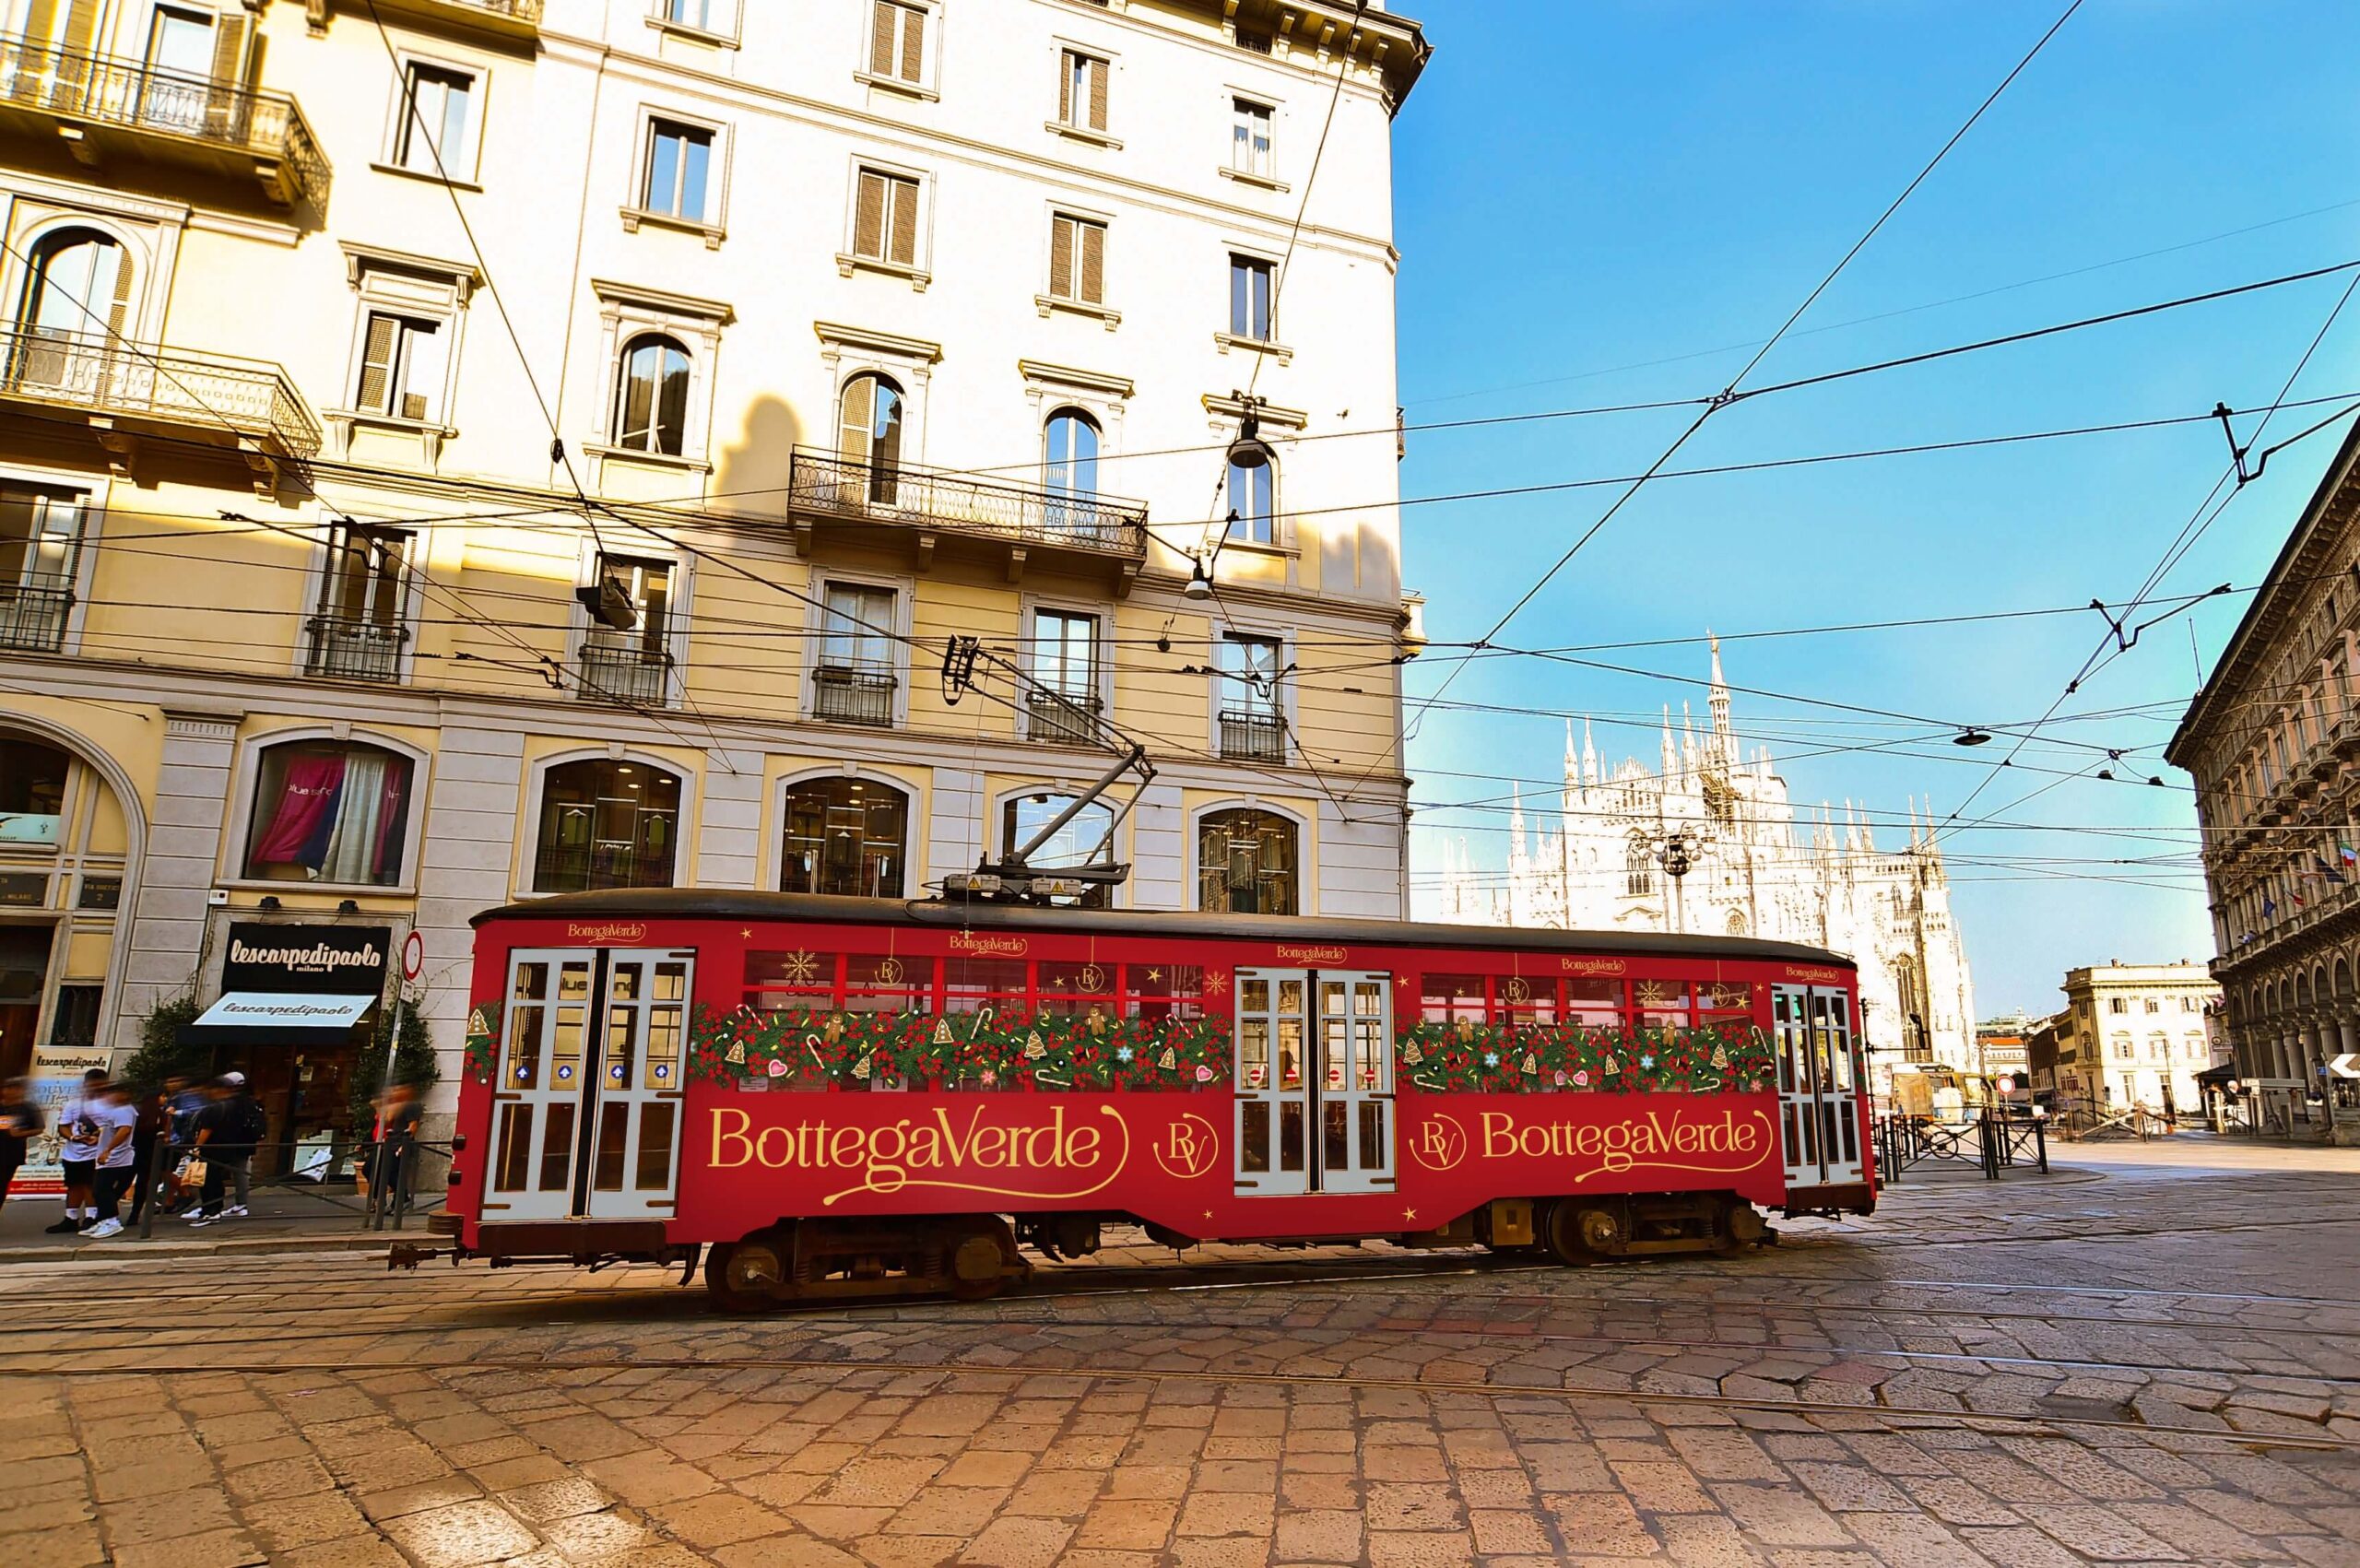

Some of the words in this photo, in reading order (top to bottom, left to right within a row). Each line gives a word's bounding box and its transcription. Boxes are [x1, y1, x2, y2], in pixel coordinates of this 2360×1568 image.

[568, 924, 646, 943] BottegaVerde
[230, 938, 381, 973] lescarpedipaolo
[950, 936, 1028, 956] BottegaVerde
[1277, 945, 1348, 964] BottegaVerde
[1562, 959, 1625, 975] BottegaVerde
[1786, 966, 1839, 983] BottegaVerde
[222, 1002, 353, 1017] lescarpedipaolo
[37, 1055, 107, 1069] lescarpedipaolo
[707, 1104, 1129, 1206] BottegaVerde
[1480, 1109, 1774, 1183] BottegaVerde
